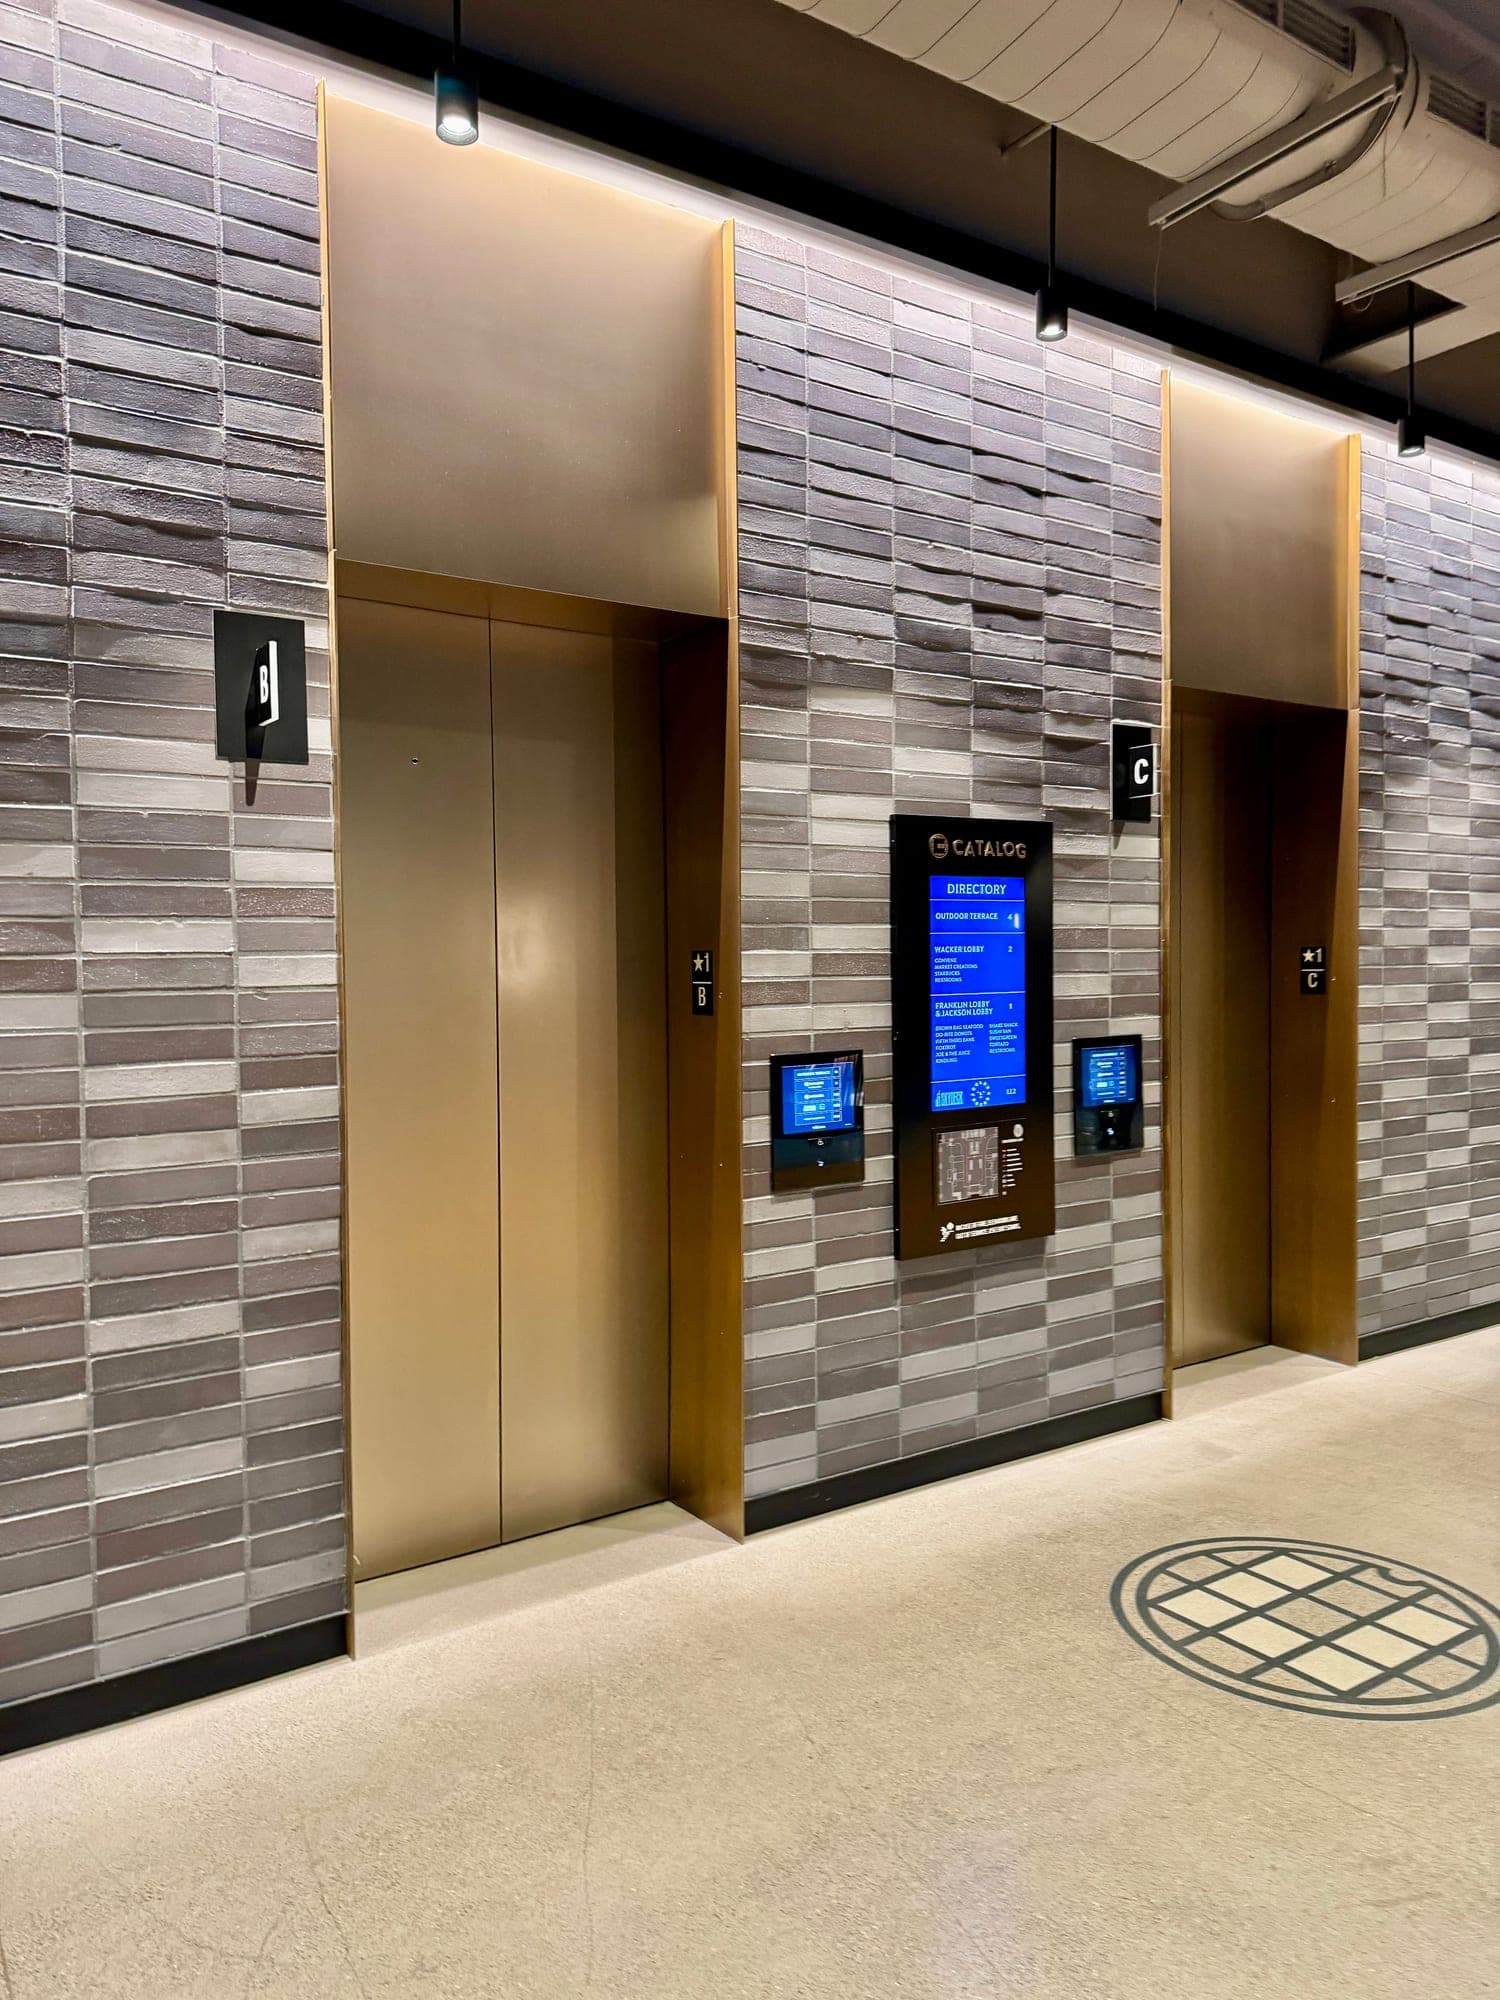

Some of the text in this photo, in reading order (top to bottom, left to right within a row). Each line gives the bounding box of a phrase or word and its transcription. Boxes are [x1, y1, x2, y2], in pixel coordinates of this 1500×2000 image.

[260, 665, 269, 704] B
[1134, 758, 1149, 785] C
[952, 839, 1027, 859] CATALOG
[947, 883, 1007, 895] DIRECTORY
[935, 912, 968, 920] OUTDOOR
[970, 912, 998, 920] TERRACE
[934, 945, 1013, 953] WACKER LOBBY 2
[1315, 948, 1322, 963] 1
[704, 952, 710, 972] 1
[1307, 972, 1319, 988] C
[698, 986, 706, 1006] B
[935, 1000, 990, 1010] FRANKLIN LOBBY
[941, 1009, 972, 1017] JACKSON
[972, 1008, 994, 1016] LOBBY
